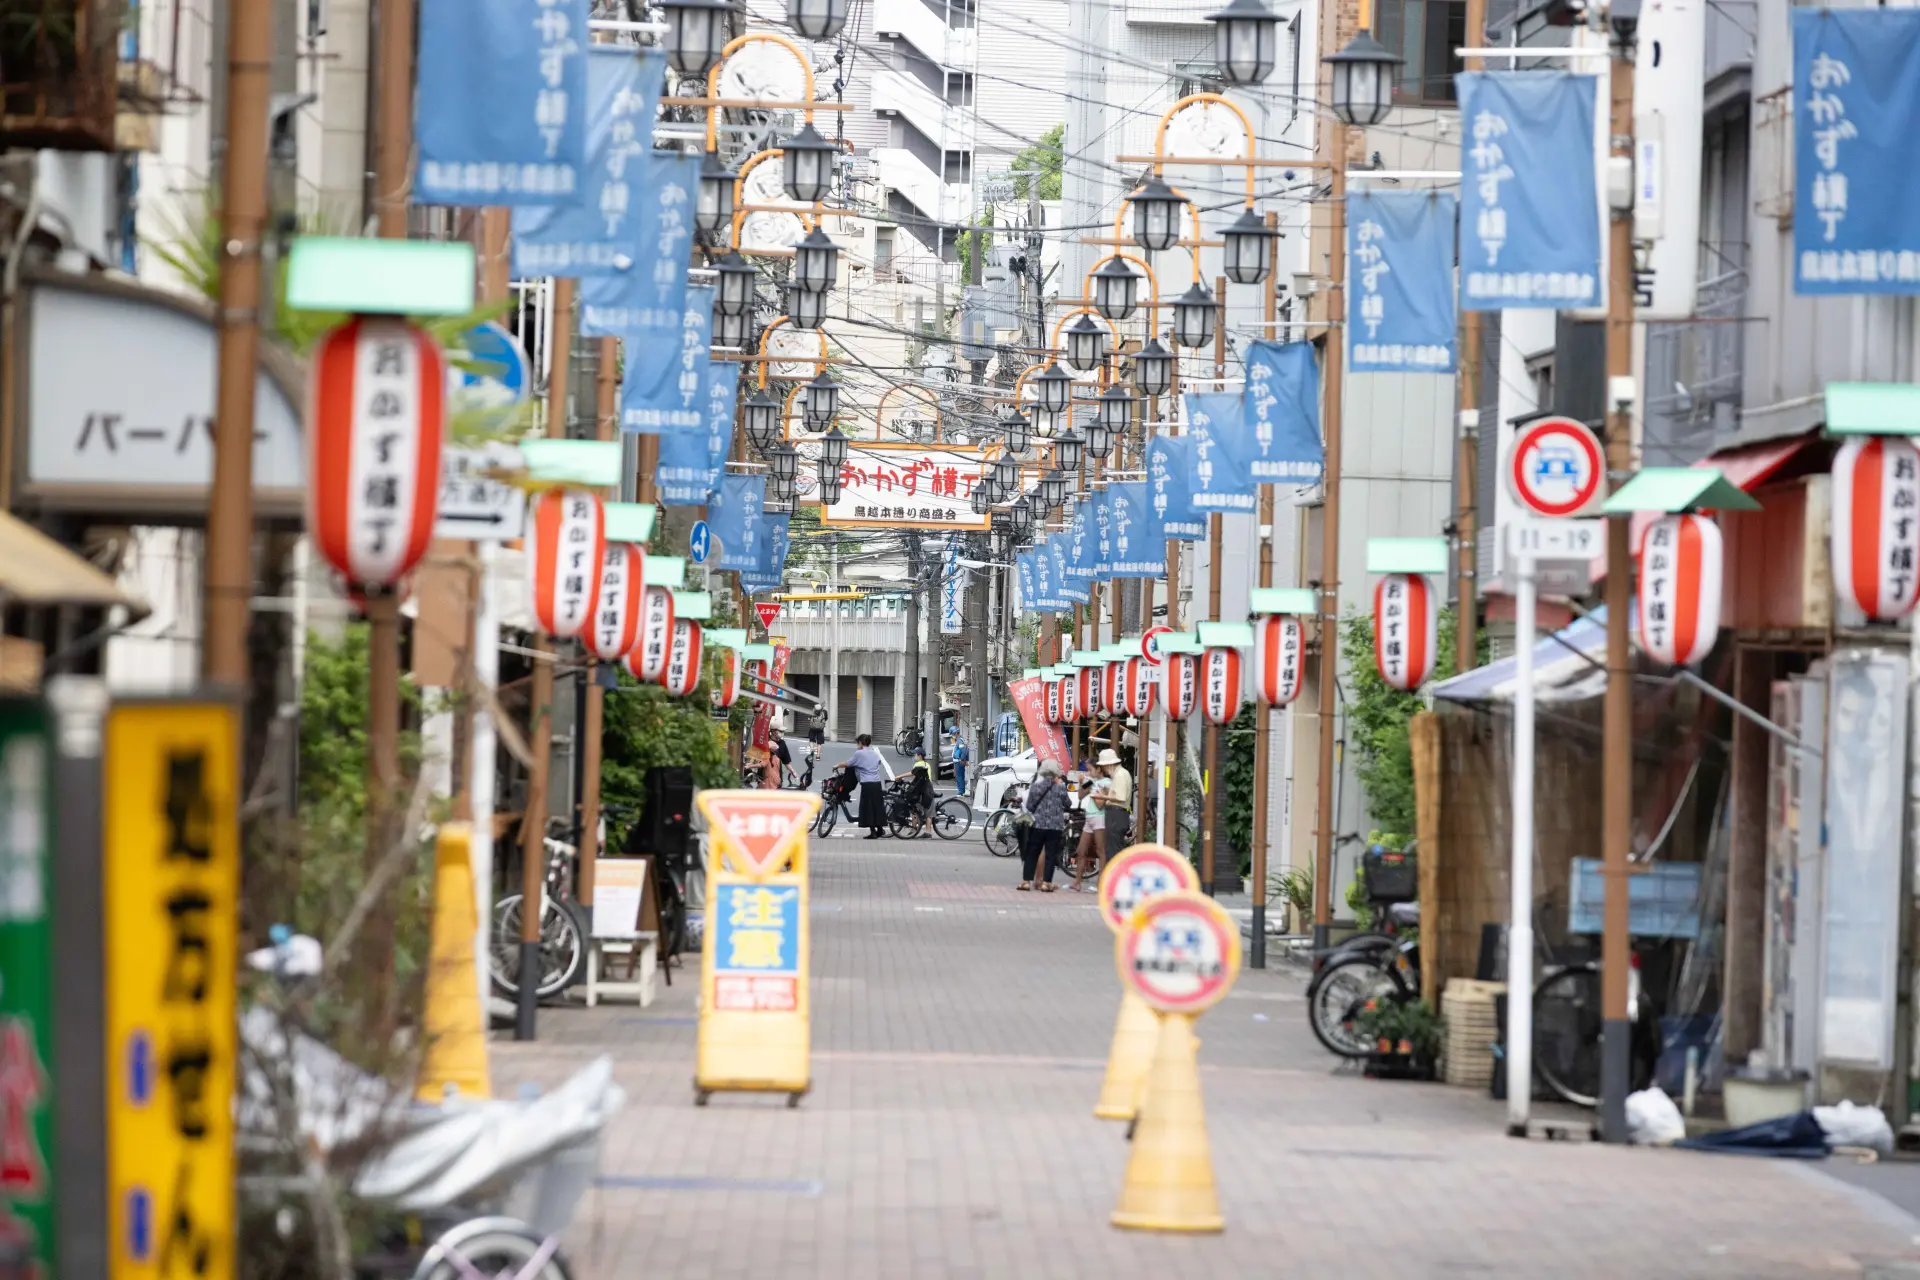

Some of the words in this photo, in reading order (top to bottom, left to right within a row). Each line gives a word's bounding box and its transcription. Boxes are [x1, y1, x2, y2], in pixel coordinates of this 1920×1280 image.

[1808, 52, 1858, 241] おかず横丁
[839, 456, 979, 498] おかず横丁
[760, 607, 777, 615] 止まれ
